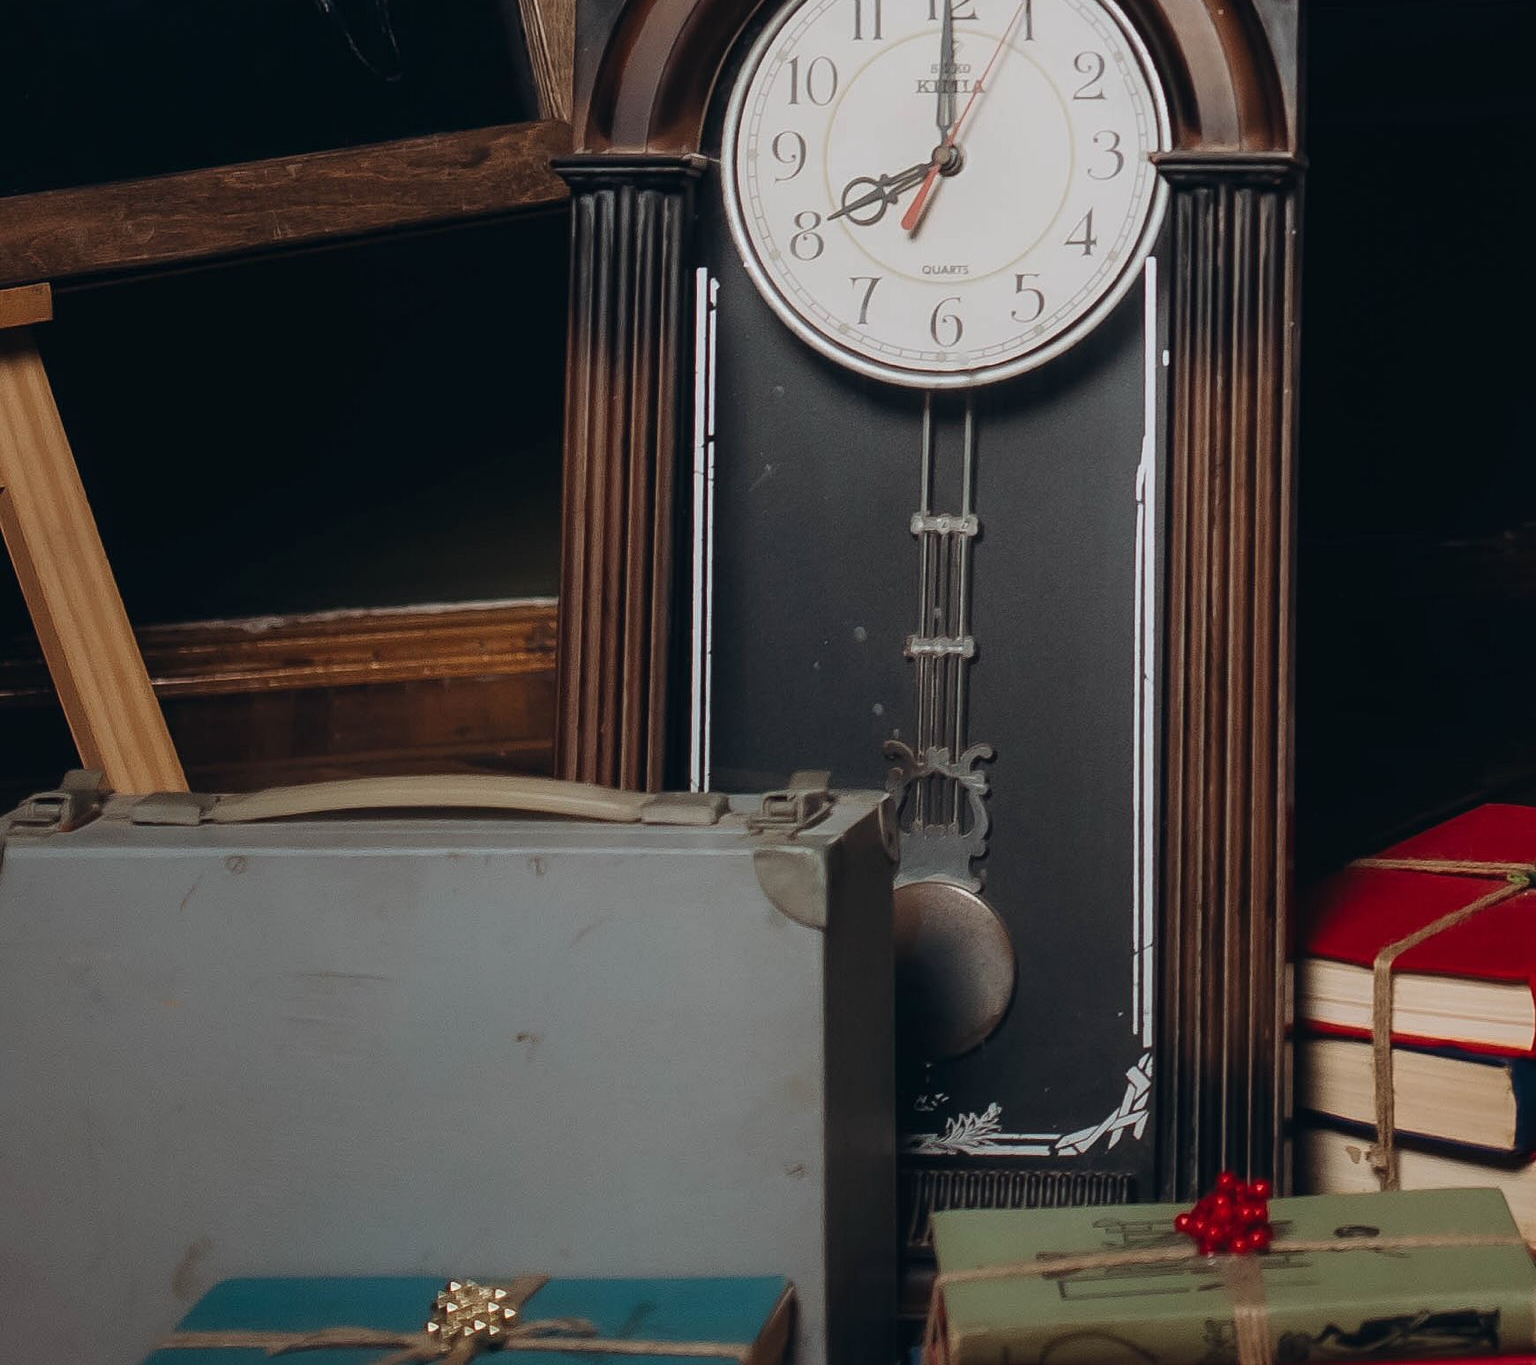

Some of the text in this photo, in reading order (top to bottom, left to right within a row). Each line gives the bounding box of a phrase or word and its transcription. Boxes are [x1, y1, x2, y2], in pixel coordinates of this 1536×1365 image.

[786, 54, 839, 107] 10
[1072, 51, 1108, 101] 2
[771, 130, 808, 182] 9
[1086, 130, 1125, 181] 3
[789, 210, 826, 262] 8
[1064, 207, 1098, 257] 4
[850, 276, 883, 326] 7
[929, 296, 964, 349] 6
[1010, 272, 1045, 324] 5
